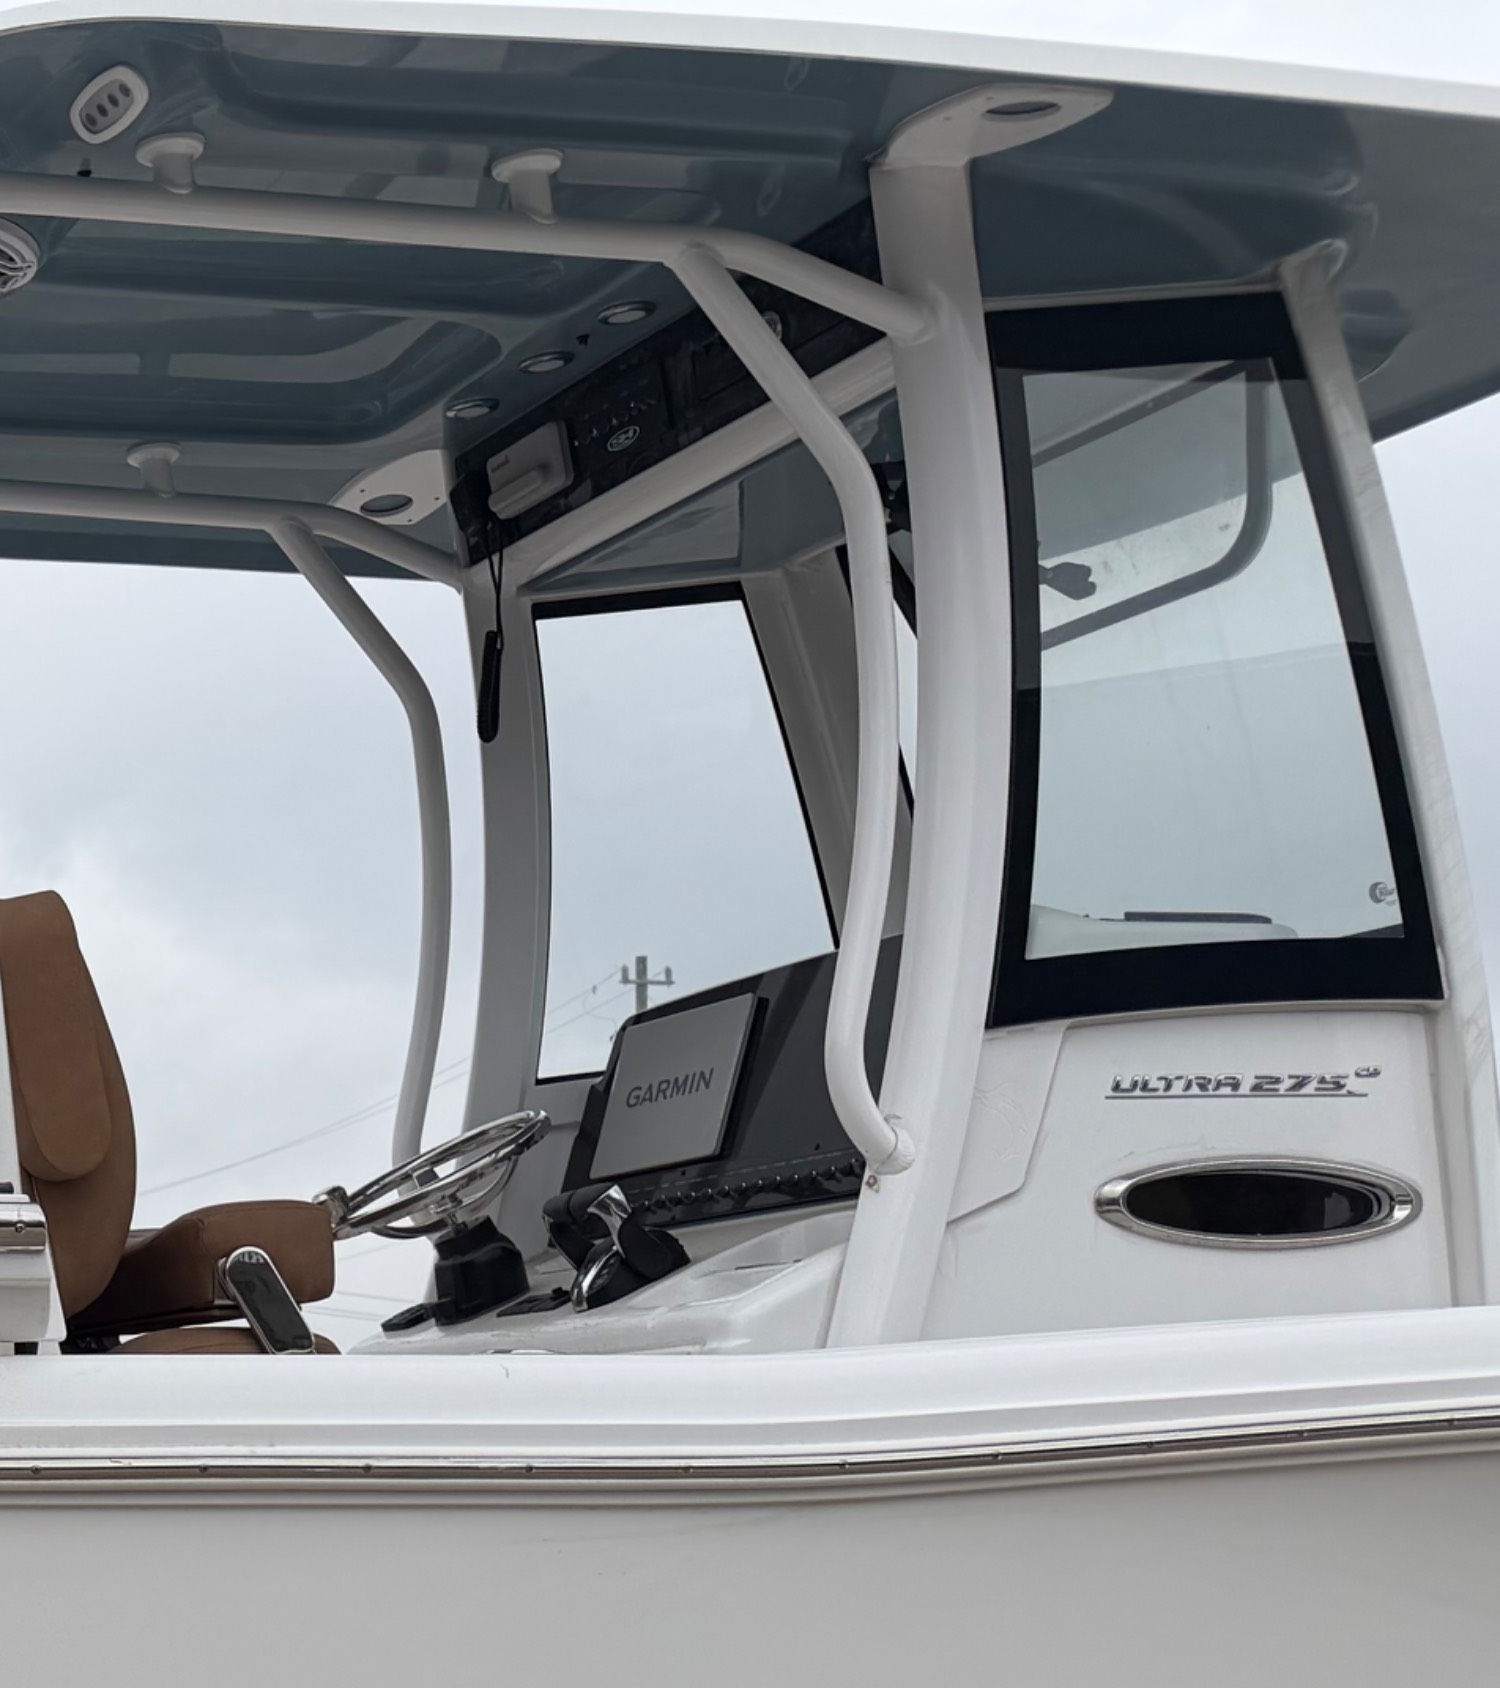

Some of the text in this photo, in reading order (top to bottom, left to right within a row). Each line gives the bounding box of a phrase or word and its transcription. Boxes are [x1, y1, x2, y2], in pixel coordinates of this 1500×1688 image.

[625, 1067, 715, 1109] GARMIN
[1111, 1073, 1244, 1093] ULTRA
[1250, 1073, 1350, 1093] 275
